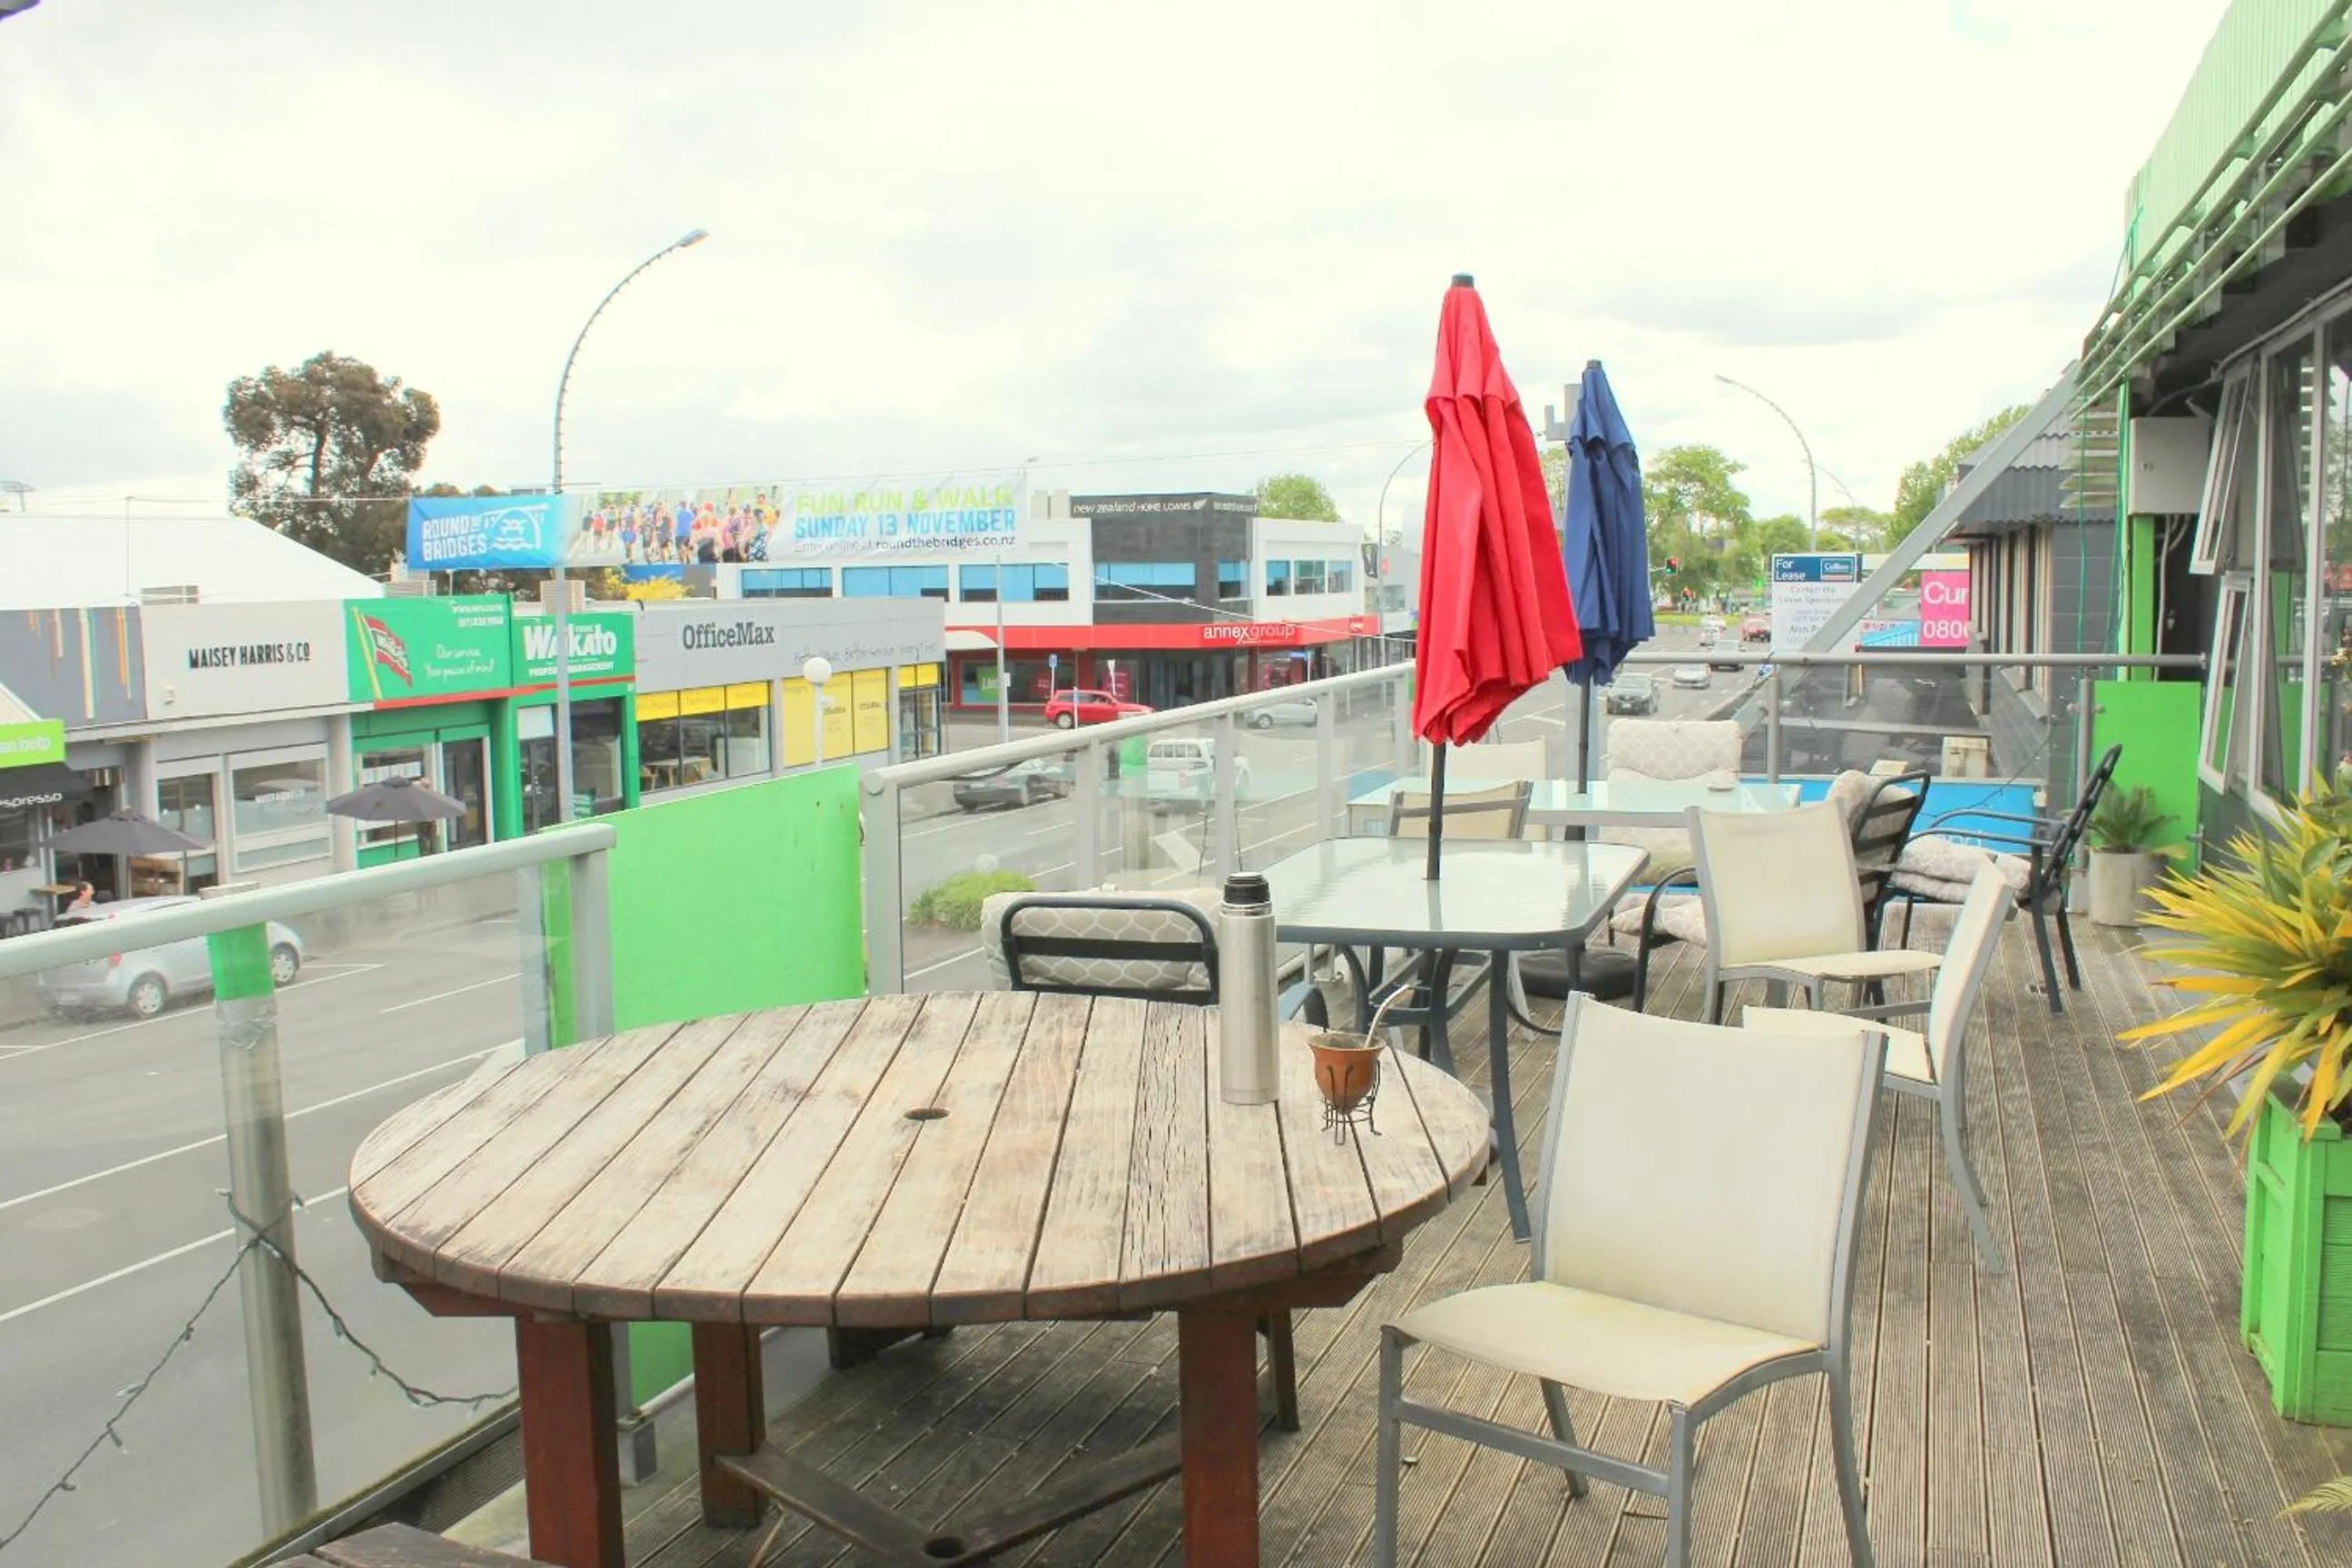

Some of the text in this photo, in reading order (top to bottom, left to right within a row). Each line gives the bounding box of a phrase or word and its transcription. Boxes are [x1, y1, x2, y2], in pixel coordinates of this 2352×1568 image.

[795, 484, 1014, 514] FUN RUN & WALK
[422, 515, 470, 540] ROUND
[795, 508, 1017, 539] SUNDAY 13 NOVEMBER
[422, 533, 488, 563] BRIDGES
[1776, 558, 1794, 569] For
[1776, 570, 1806, 582] Lease
[682, 621, 776, 651] OfficeMax
[189, 646, 237, 670] MAISEY
[240, 642, 284, 666] HARRIS
[286, 642, 295, 663] &
